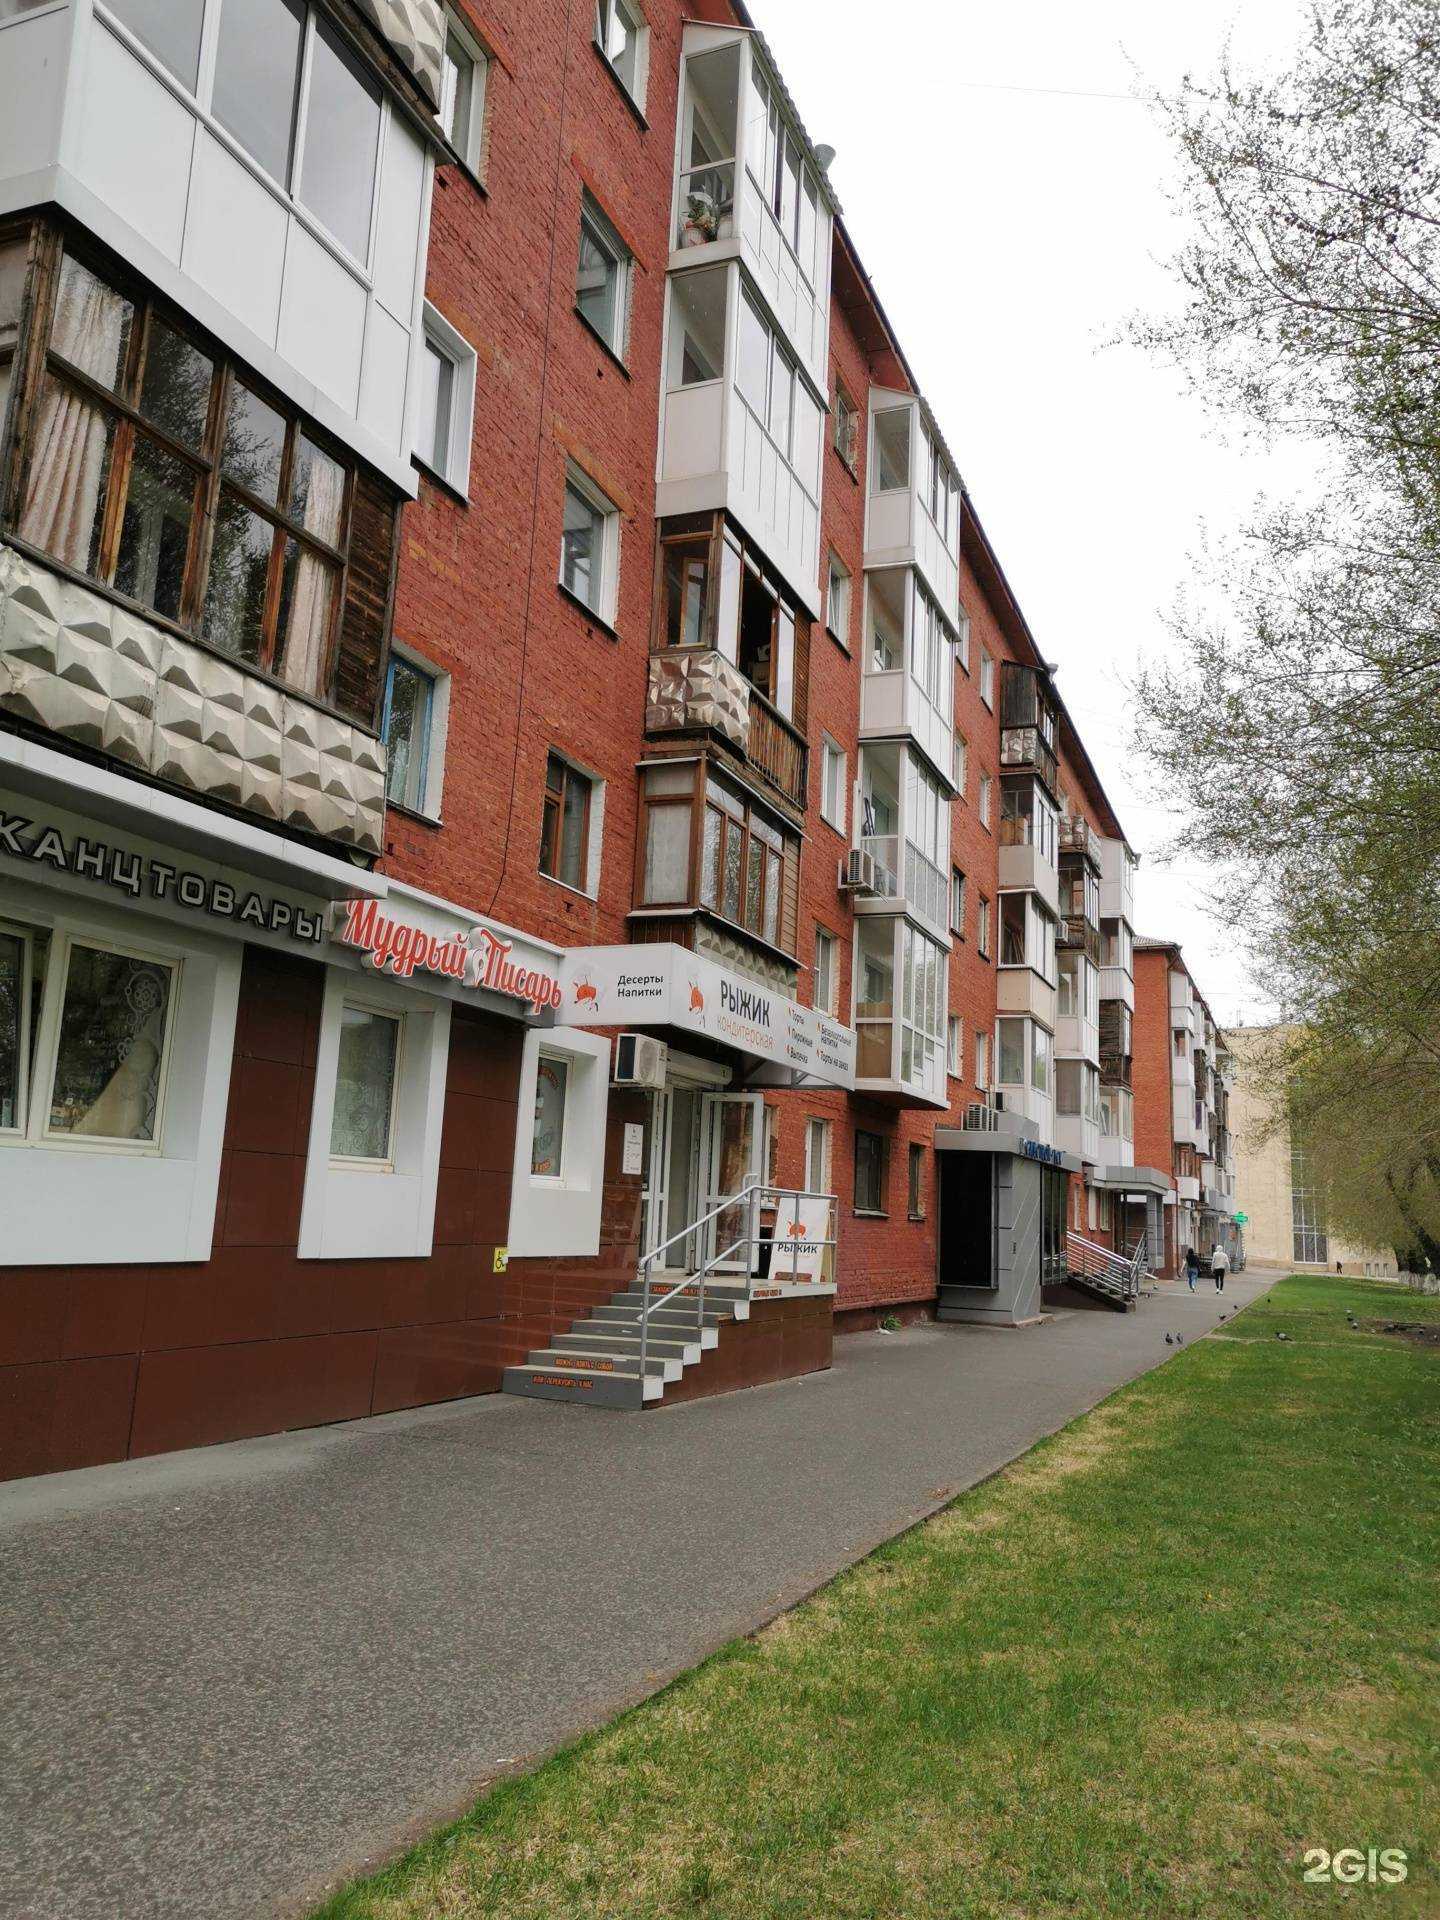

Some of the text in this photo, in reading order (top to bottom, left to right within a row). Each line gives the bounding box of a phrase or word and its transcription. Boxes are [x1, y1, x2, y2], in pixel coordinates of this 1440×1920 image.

[0, 813, 324, 943] КАНЦТОВАРЫ
[343, 899, 563, 1015] Мудрый Писарь
[617, 975, 664, 986] Десерты
[617, 988, 662, 998] Напитки
[720, 979, 770, 1028] РЫЖИК
